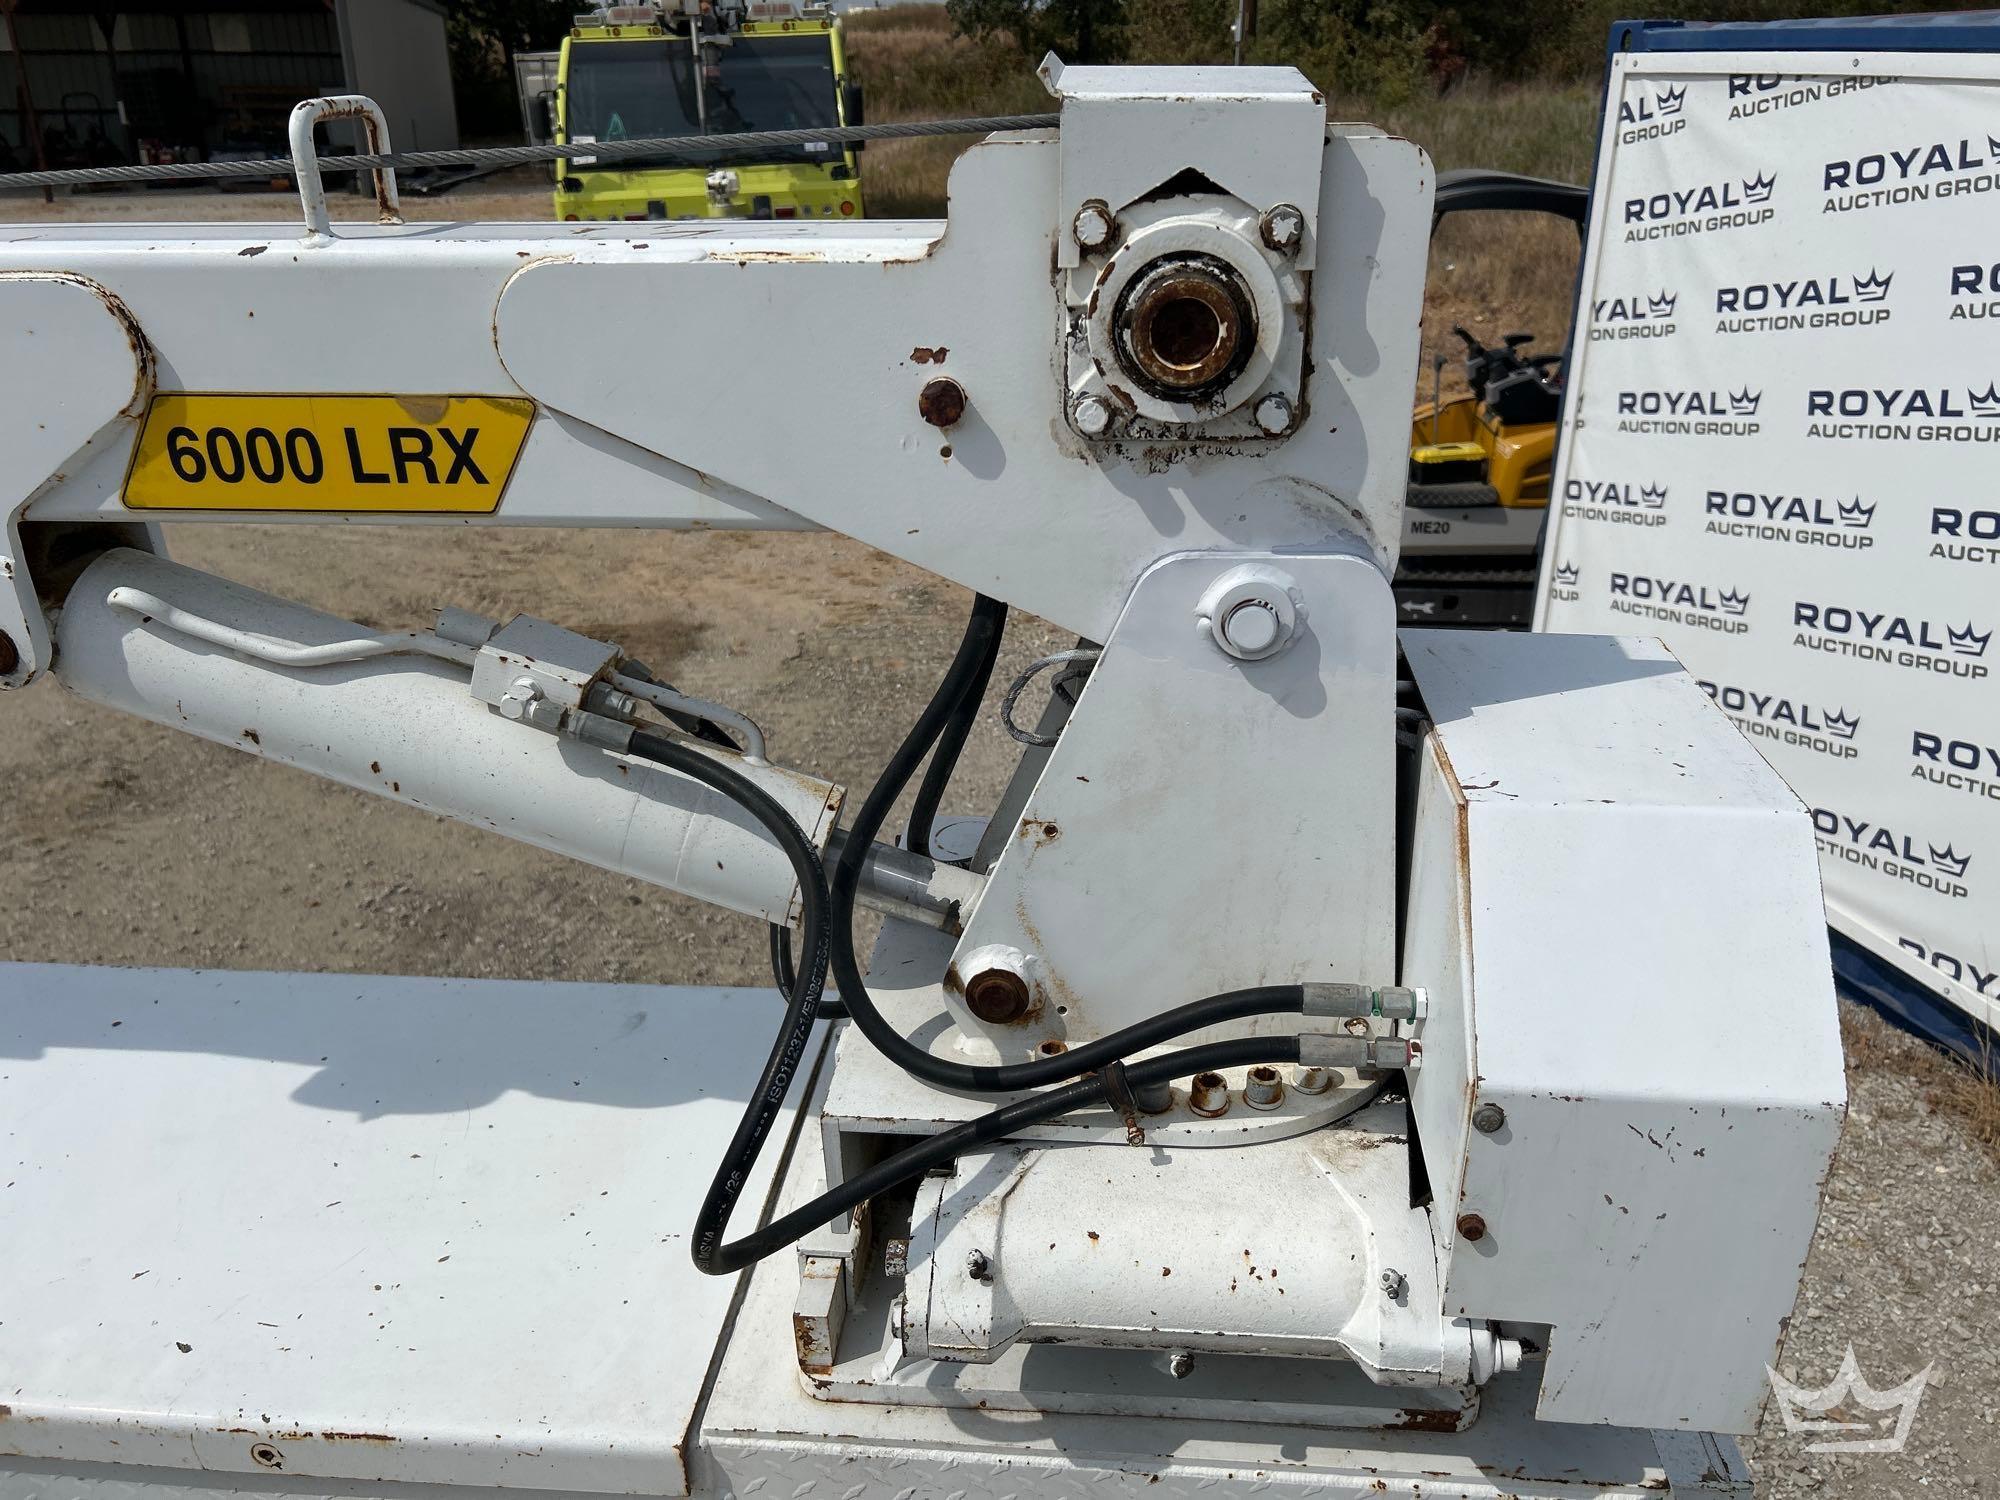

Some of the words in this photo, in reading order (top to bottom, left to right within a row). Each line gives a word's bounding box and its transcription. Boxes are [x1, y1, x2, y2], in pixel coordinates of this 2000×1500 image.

[1728, 85, 1821, 120] AUCTION
[1827, 75, 1900, 98] GROU
[1623, 119, 1686, 144] GROUP
[1824, 139, 1983, 191] ROYAL
[1625, 183, 1739, 224] ROYAL
[1823, 184, 1929, 213] AUCTION
[1624, 219, 1701, 243] AUCTION
[1706, 209, 1774, 232] GROUP
[1592, 297, 1646, 322] YAL
[1716, 278, 1849, 313] ROYAL
[1618, 324, 1676, 340] GROUP
[1715, 315, 1805, 333] AUCTION
[1809, 309, 1890, 328] GROUP
[1618, 391, 1726, 415] ROYAL
[1807, 389, 1964, 417] ROYAL
[1618, 419, 1690, 434] AUCTION
[1694, 421, 1760, 436] GROUP
[1807, 423, 1911, 440] AUCTION
[166, 426, 324, 484] 6000
[344, 427, 490, 484] LRX
[1566, 480, 1639, 506] OYAL
[1563, 506, 1608, 522] CTION
[1611, 511, 1666, 527] GROUP
[1705, 491, 1834, 525] ROYAL
[1410, 521, 1450, 535] ME20
[1705, 521, 1790, 542] AUCTION
[1795, 530, 1873, 550] GROUP
[1930, 542, 2000, 564] AUCT
[1610, 572, 1716, 611] ROYAL
[1610, 599, 1681, 623] AUCTION
[1685, 613, 1749, 635] GROUP
[1793, 601, 1943, 651] ROYAL
[1793, 632, 1892, 663] AUCTION
[1898, 651, 1988, 679] GROUP
[1784, 731, 1858, 759] GROUP
[1812, 808, 1925, 865] OYAL
[1882, 861, 1969, 898] GROUP
